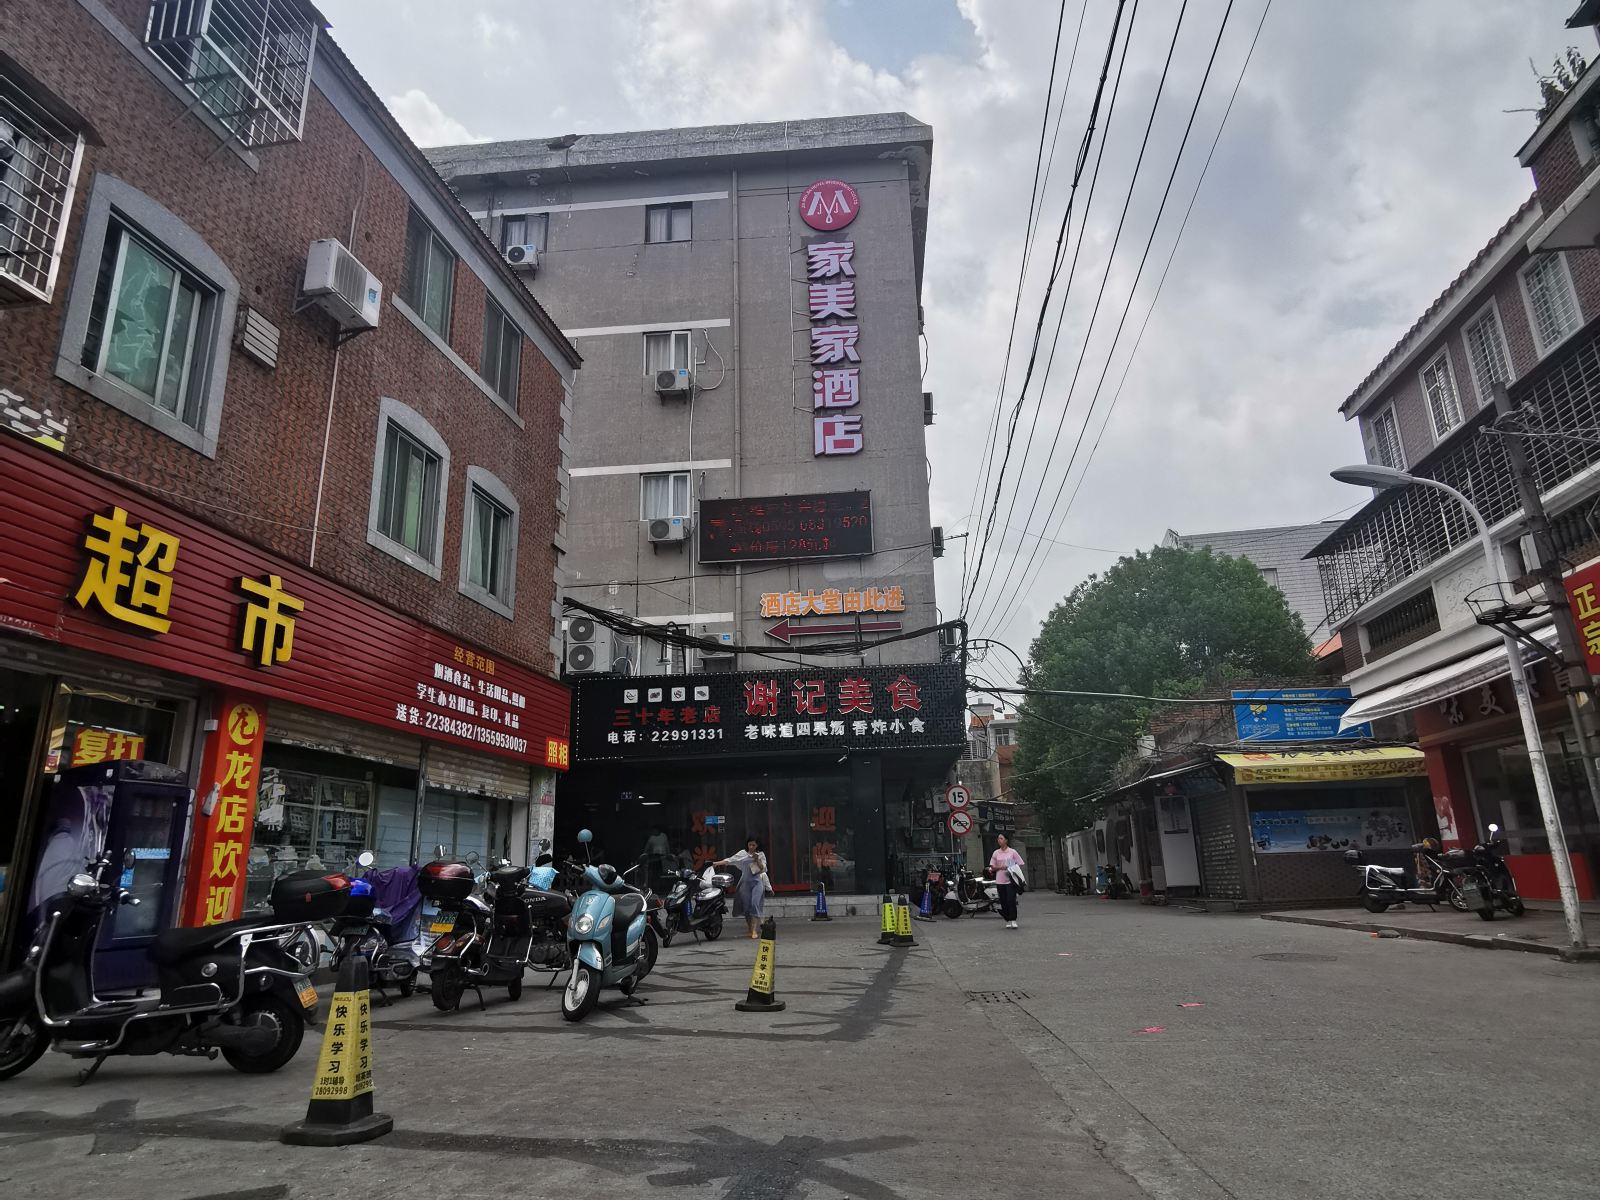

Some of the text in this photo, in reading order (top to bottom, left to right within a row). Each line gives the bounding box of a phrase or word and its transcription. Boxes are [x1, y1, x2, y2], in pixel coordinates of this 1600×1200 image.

[806, 241, 863, 456] 家美家酒店
[75, 506, 305, 667] 超市
[760, 585, 906, 618] 酒店大堂由此进
[454, 646, 496, 676] 经营范围
[416, 682, 520, 730] 学生办公用品、复印、礼品
[743, 674, 923, 717] 谢记美食
[612, 704, 721, 727] 三十年老店
[744, 717, 926, 740] 老味道四果汤 香炸小食
[73, 728, 145, 765] 复打
[547, 740, 568, 766] 照相
[952, 792, 965, 803] 15
[205, 750, 254, 926] 龙店欢迎
[328, 1005, 348, 1073] 快乐学习
[359, 1003, 369, 1069] 快乐学习
[315, 1086, 348, 1096] 28092998
